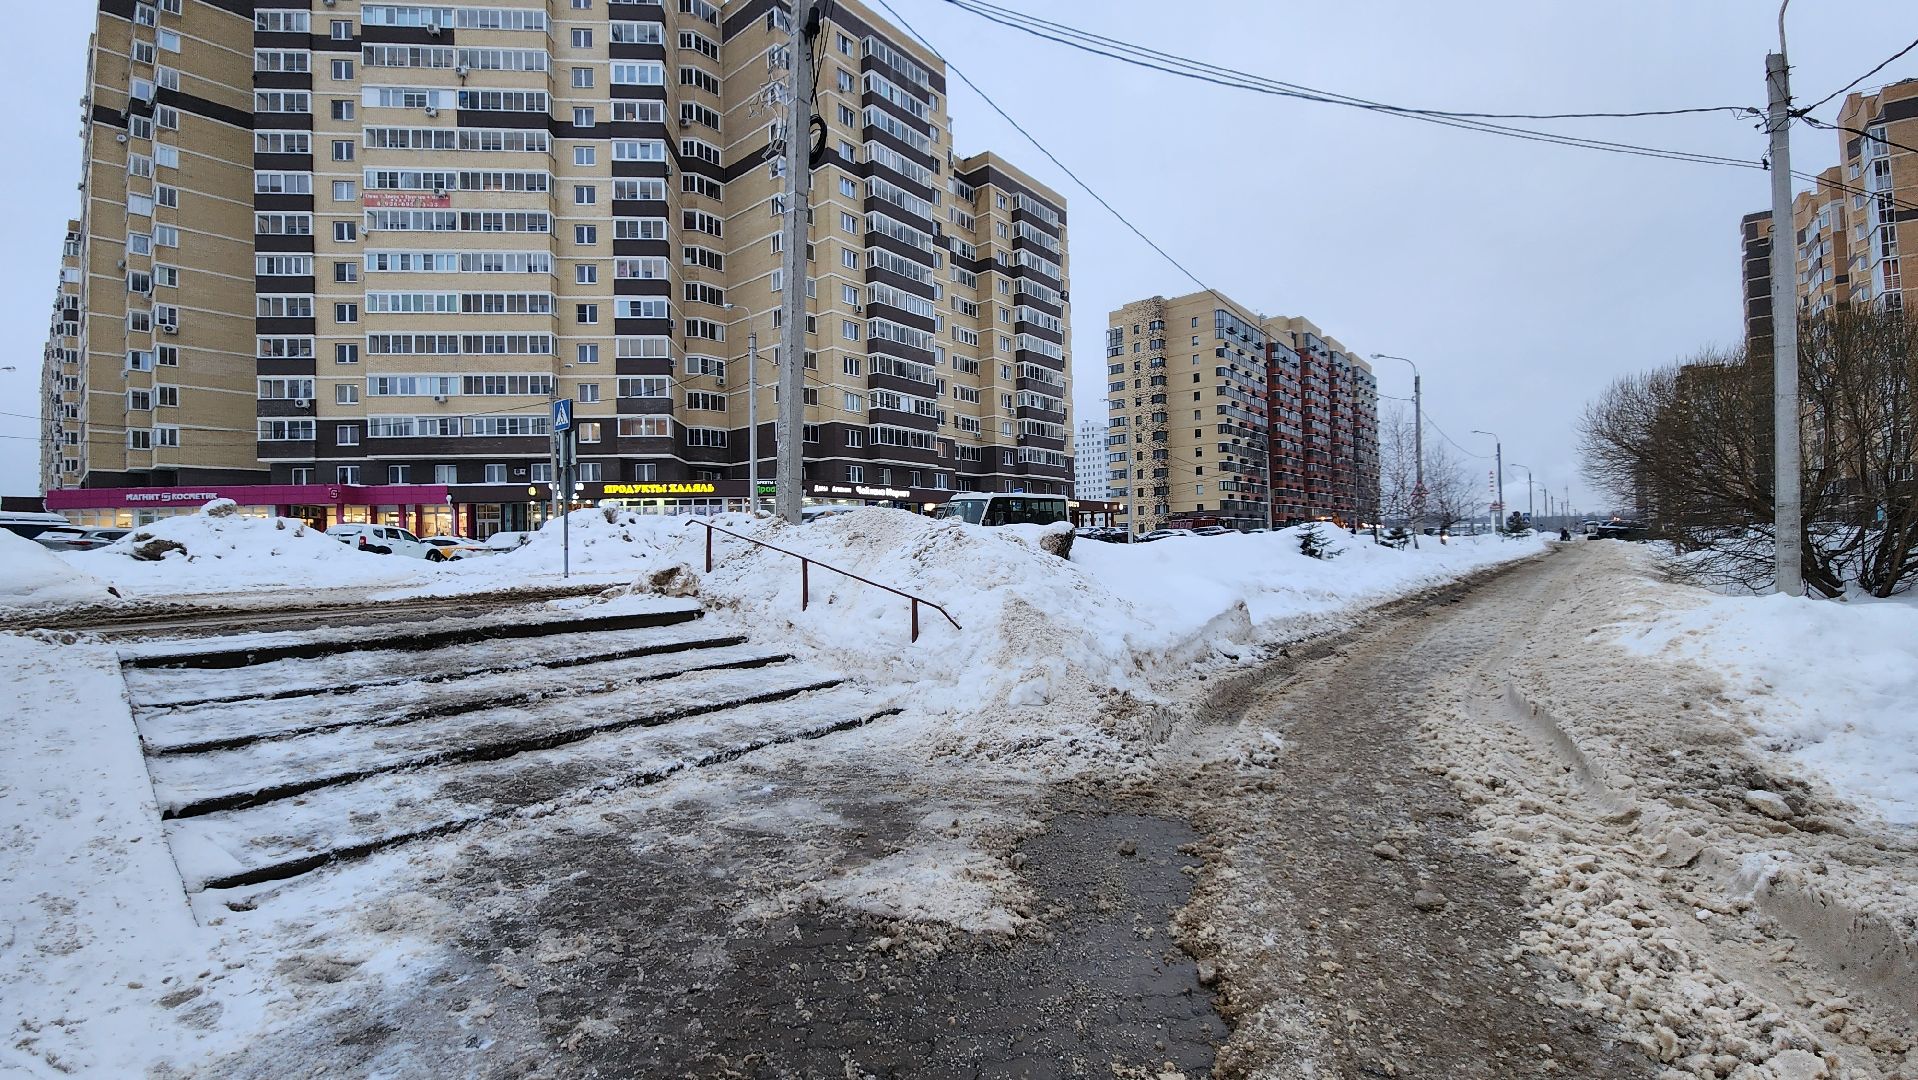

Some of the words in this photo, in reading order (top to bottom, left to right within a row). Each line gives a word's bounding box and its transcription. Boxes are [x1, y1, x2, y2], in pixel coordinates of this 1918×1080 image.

[604, 484, 667, 494] ПРОДУКТЫ
[669, 483, 714, 493] ХАЛЯЛЬ
[126, 493, 160, 501] МАГНИТ
